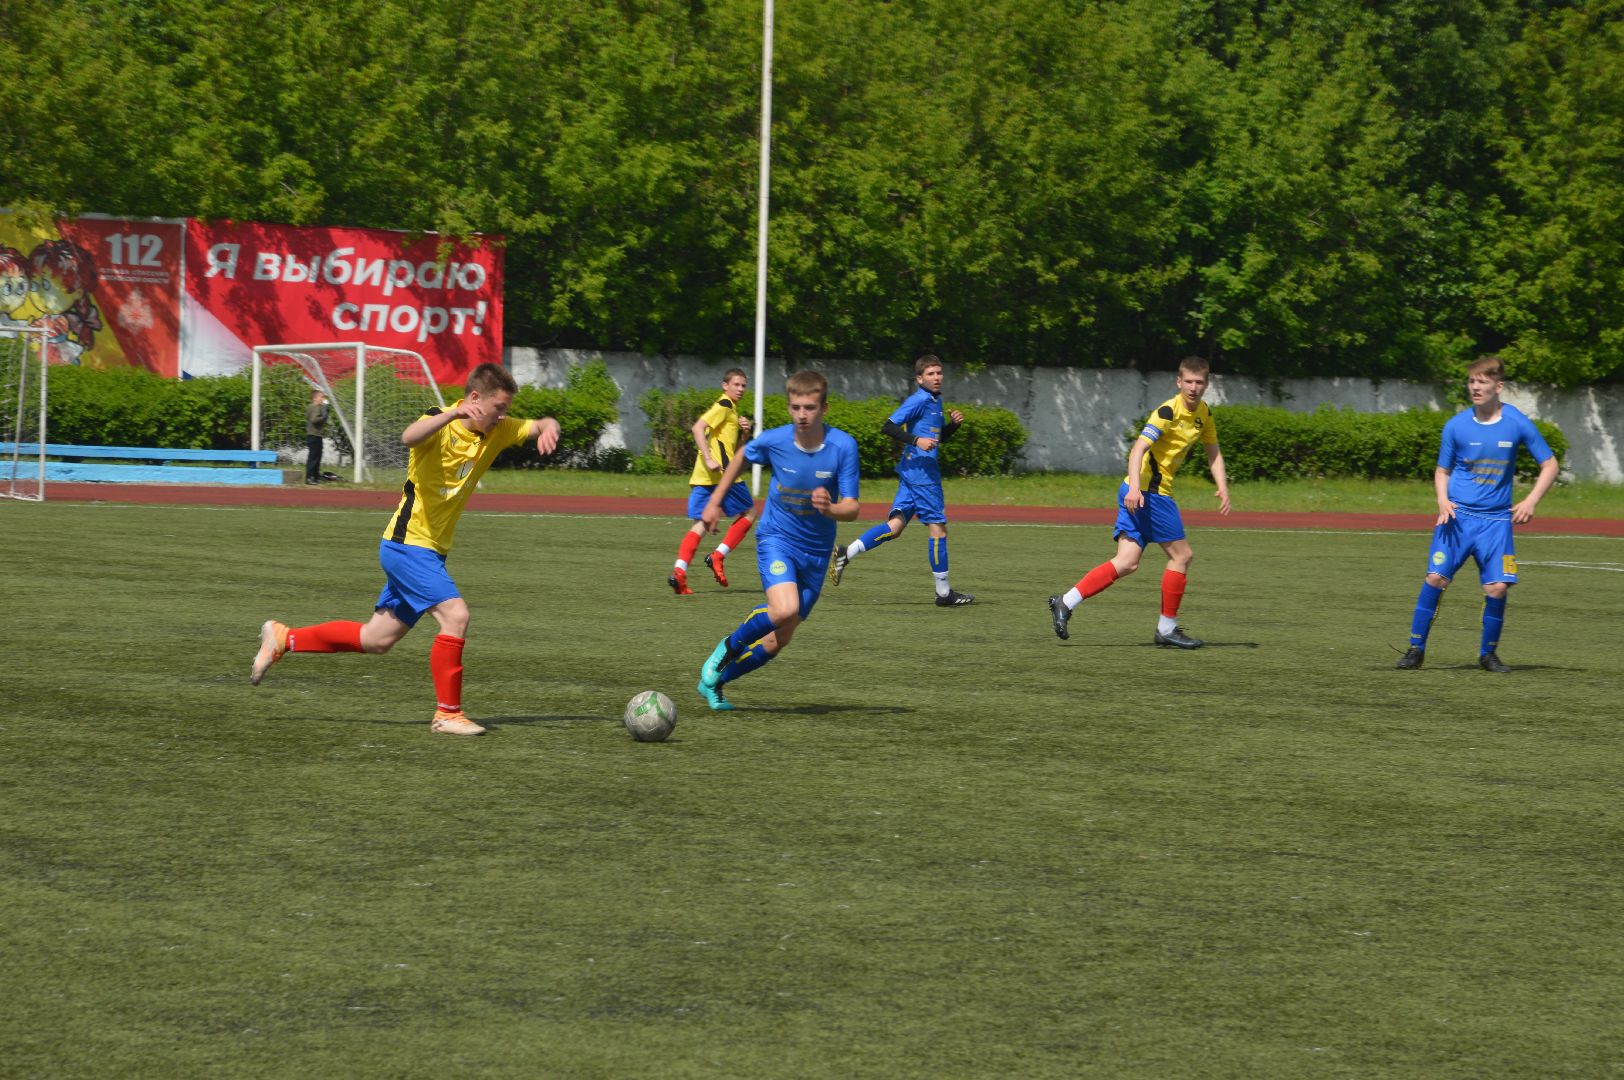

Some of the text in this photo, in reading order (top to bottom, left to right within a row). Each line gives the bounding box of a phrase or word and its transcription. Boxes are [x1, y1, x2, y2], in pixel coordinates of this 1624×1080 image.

[105, 233, 163, 267] 112
[204, 242, 486, 297] Я выбираю
[332, 301, 488, 343] спорт!
